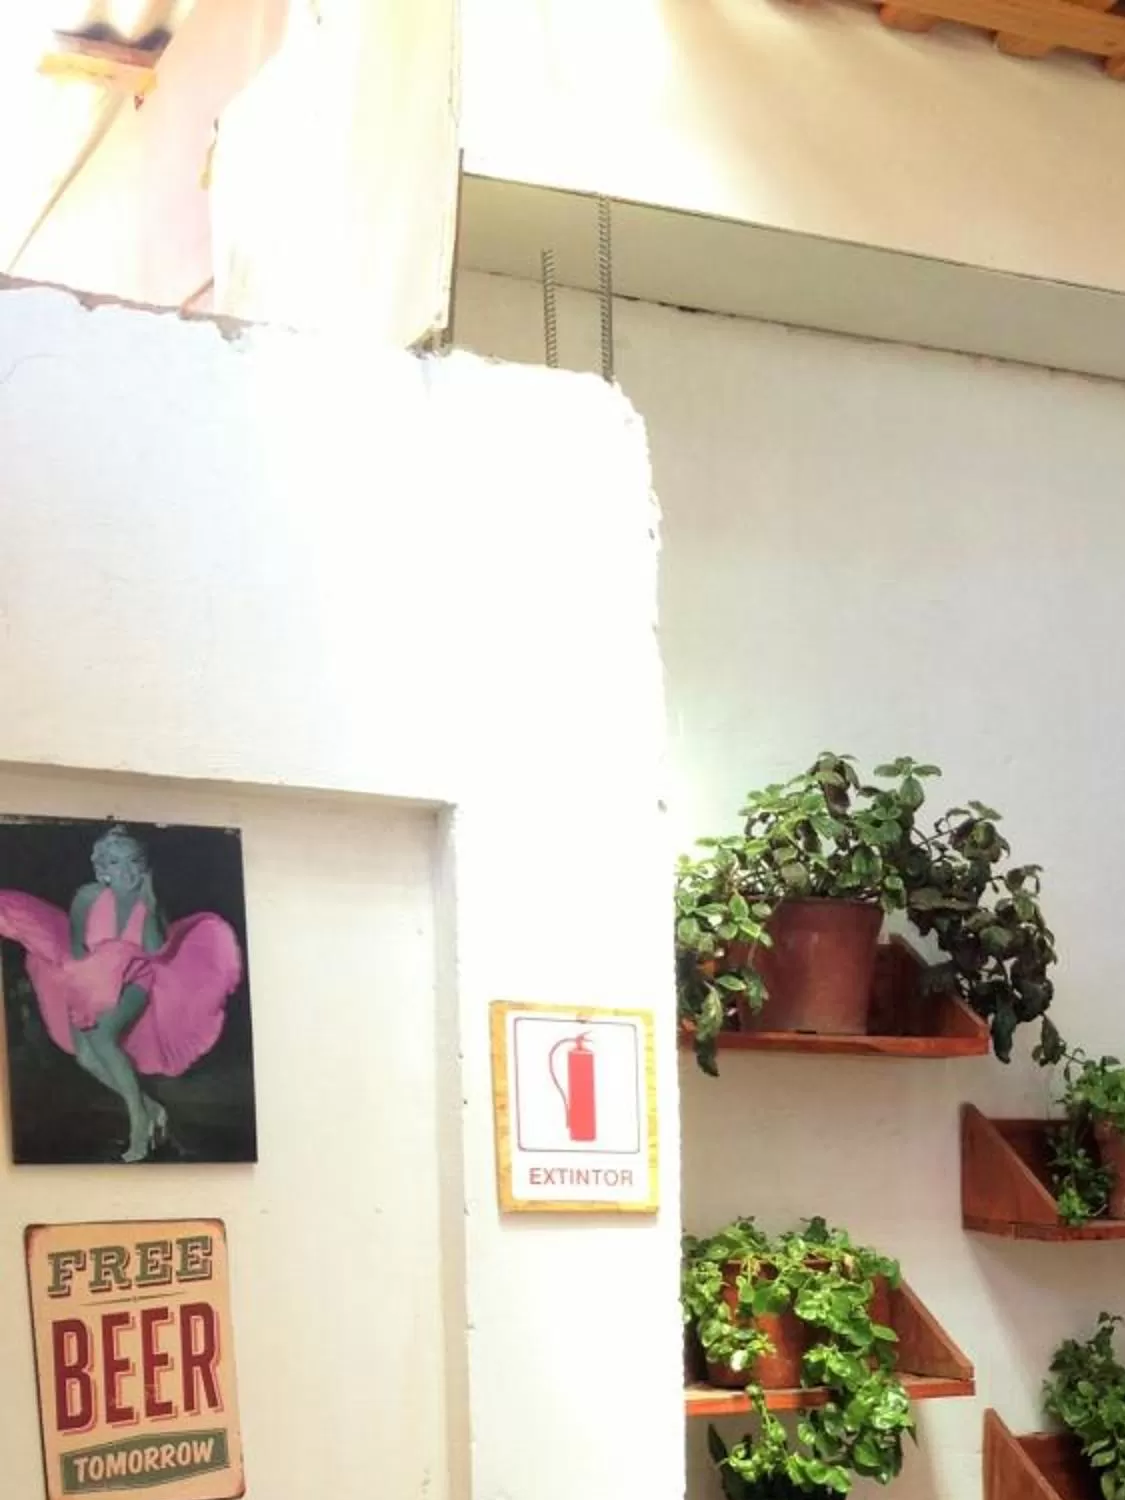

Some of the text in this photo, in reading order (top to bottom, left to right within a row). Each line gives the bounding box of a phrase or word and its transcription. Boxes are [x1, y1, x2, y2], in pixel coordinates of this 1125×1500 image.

[528, 1166, 633, 1186] EXTINTOR
[47, 1235, 213, 1299] FREE
[52, 1301, 224, 1436] BEER
[73, 1437, 215, 1484] TOMORROW
